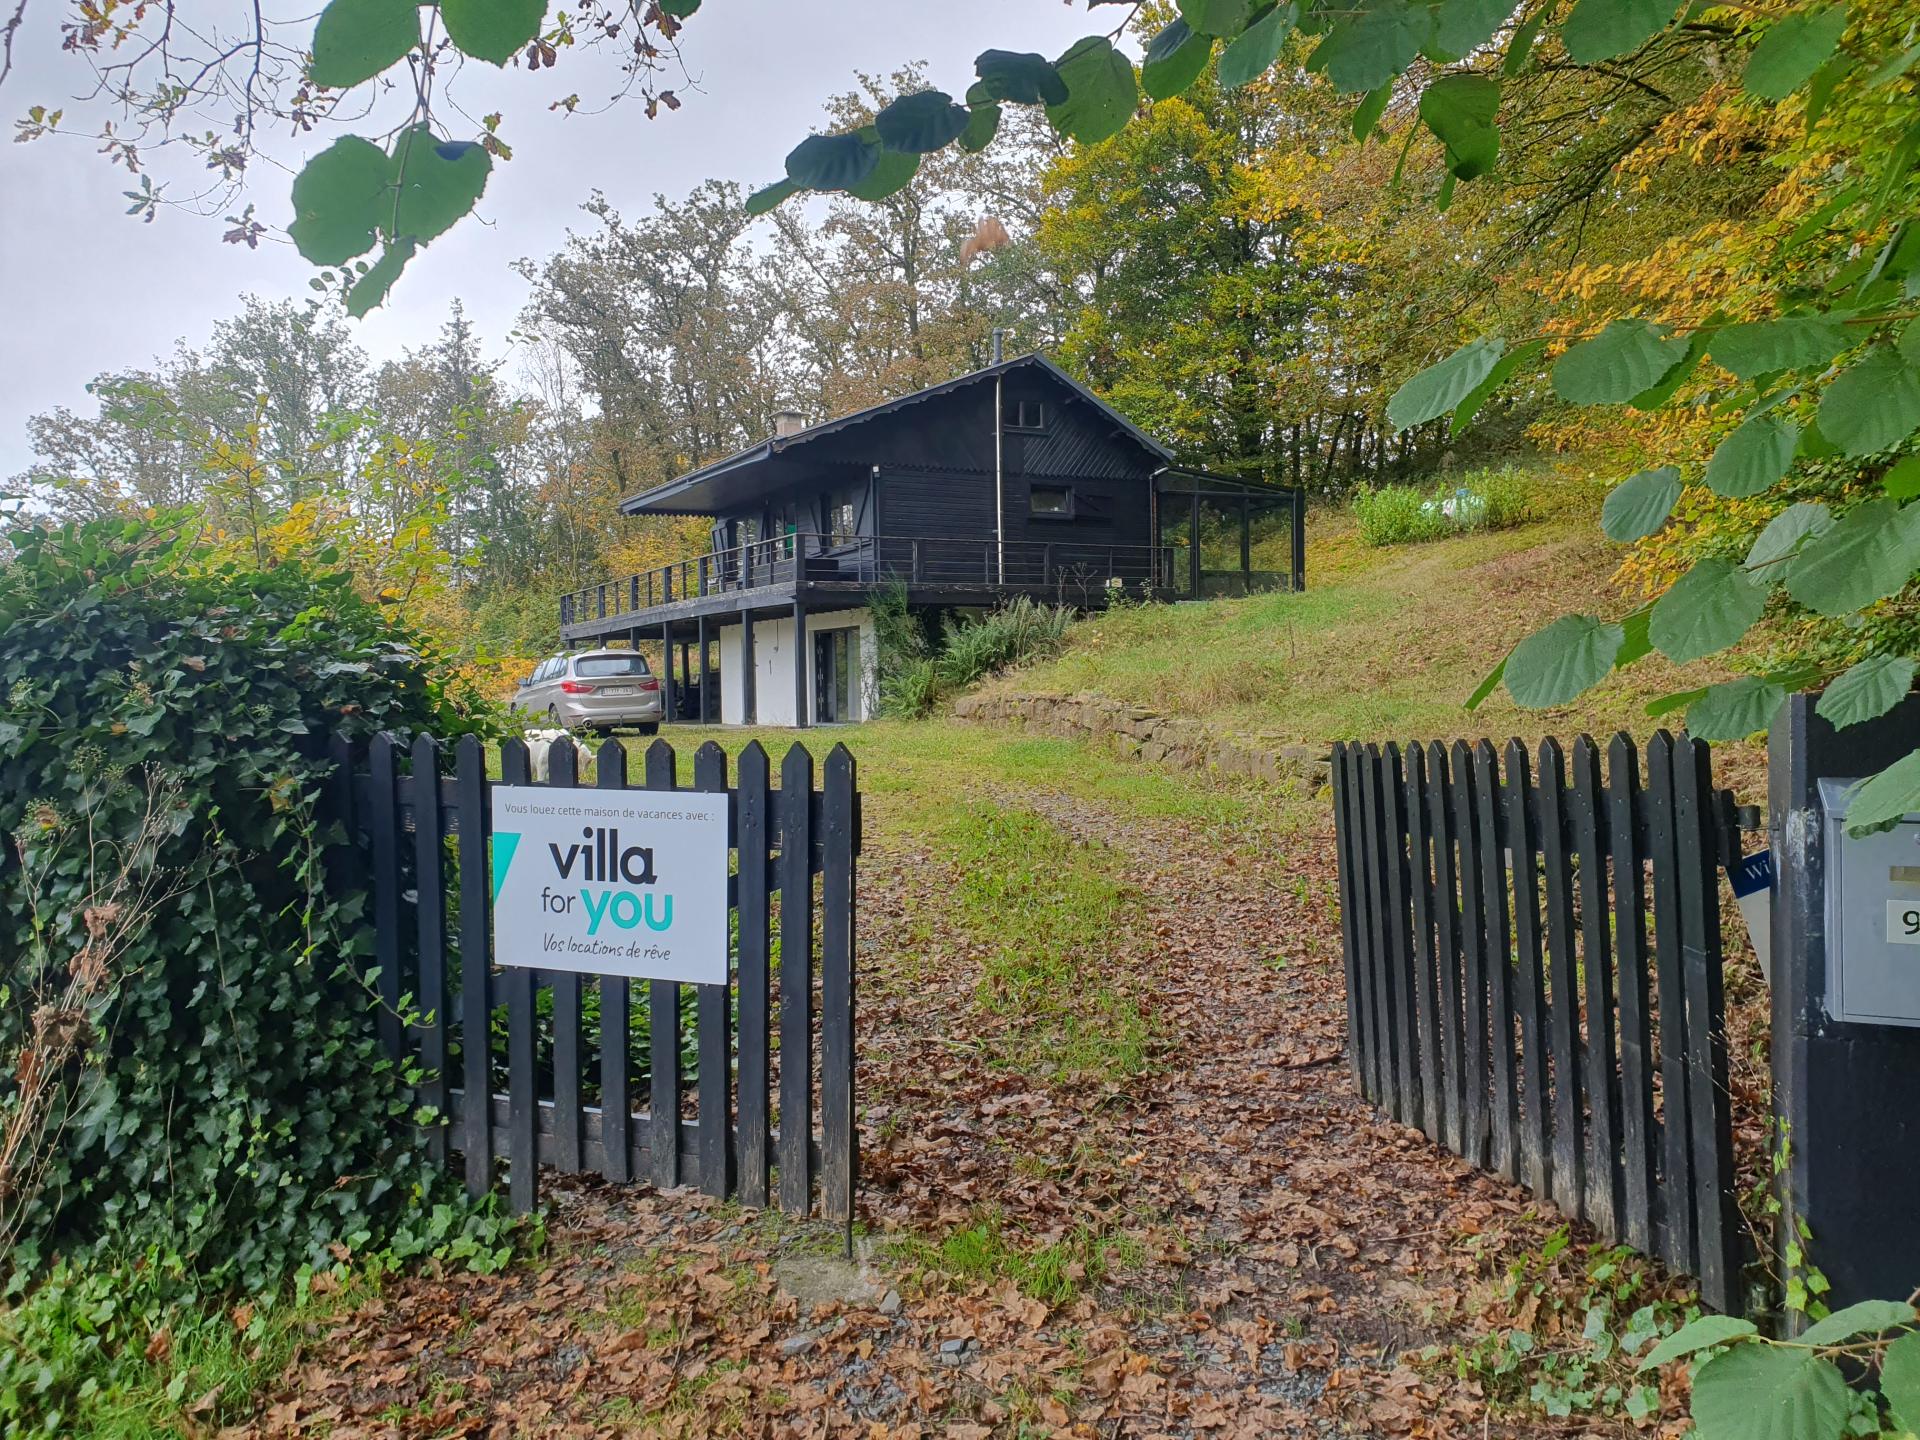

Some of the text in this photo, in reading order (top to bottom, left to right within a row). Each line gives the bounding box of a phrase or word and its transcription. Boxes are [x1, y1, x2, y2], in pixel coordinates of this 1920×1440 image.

[505, 804, 528, 813] Vous
[530, 804, 555, 815] louez
[558, 807, 581, 816] cette
[584, 808, 619, 817] maison
[623, 808, 635, 818] de
[638, 810, 683, 819] vacances
[549, 826, 657, 884] villa
[1745, 860, 1770, 881] Wi
[541, 887, 673, 935] for you
[544, 932, 670, 960] Vos locations de rêve
